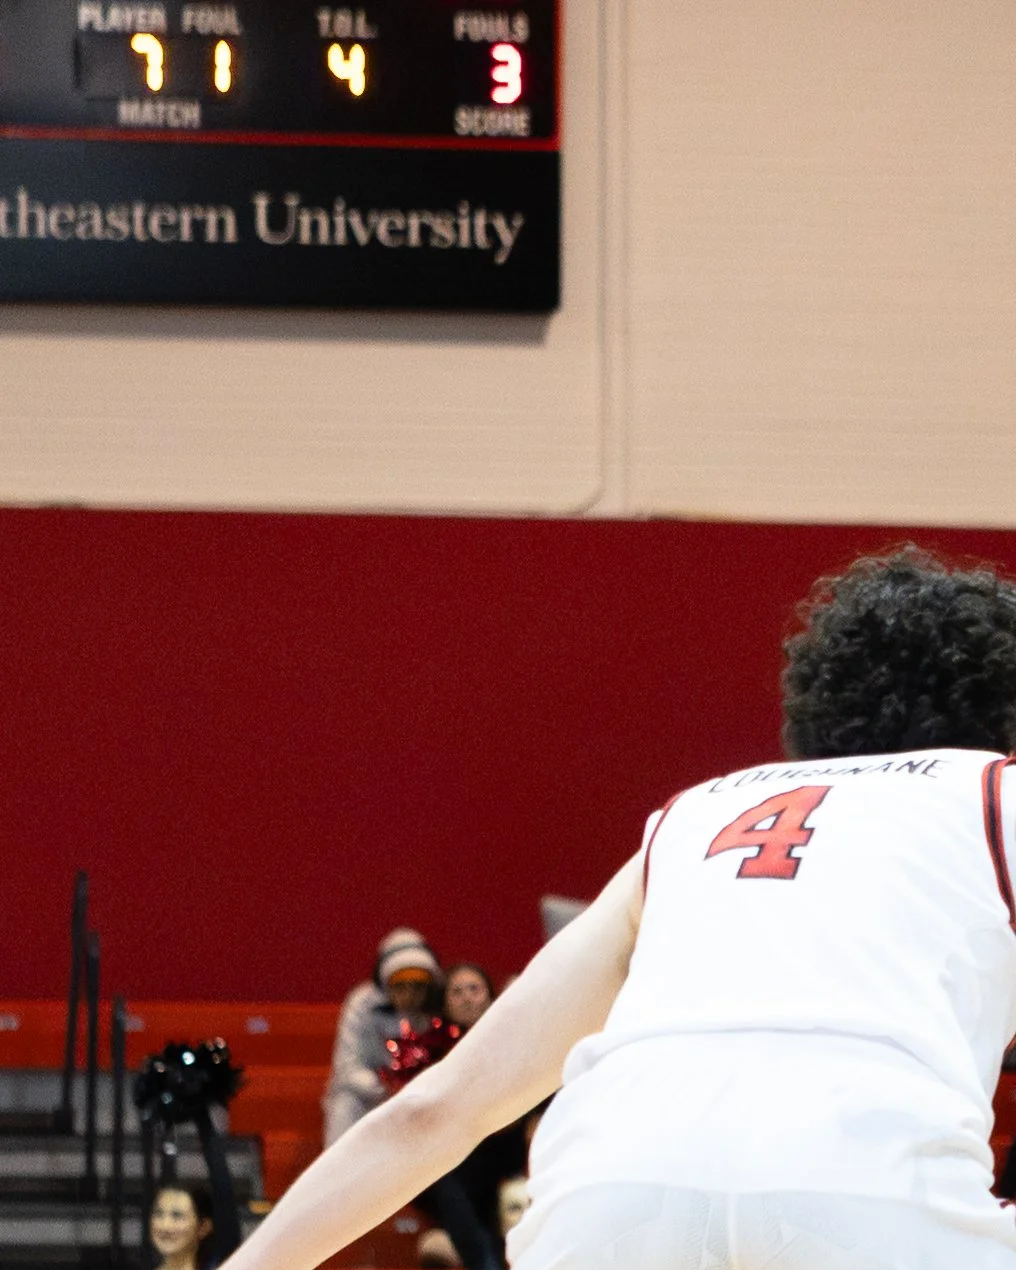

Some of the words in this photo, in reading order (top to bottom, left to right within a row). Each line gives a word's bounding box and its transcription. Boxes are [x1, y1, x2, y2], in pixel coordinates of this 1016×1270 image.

[78, 2, 167, 34] PLAYER
[182, 4, 241, 36] FOUL
[454, 10, 529, 43] FOULS
[131, 33, 163, 92] 7
[214, 40, 231, 93] 1
[328, 43, 365, 96] 4
[491, 43, 522, 104] 3
[117, 98, 200, 129] MATCH
[454, 106, 530, 137] SCORE
[253, 190, 523, 264] University
[703, 785, 834, 881] 4
